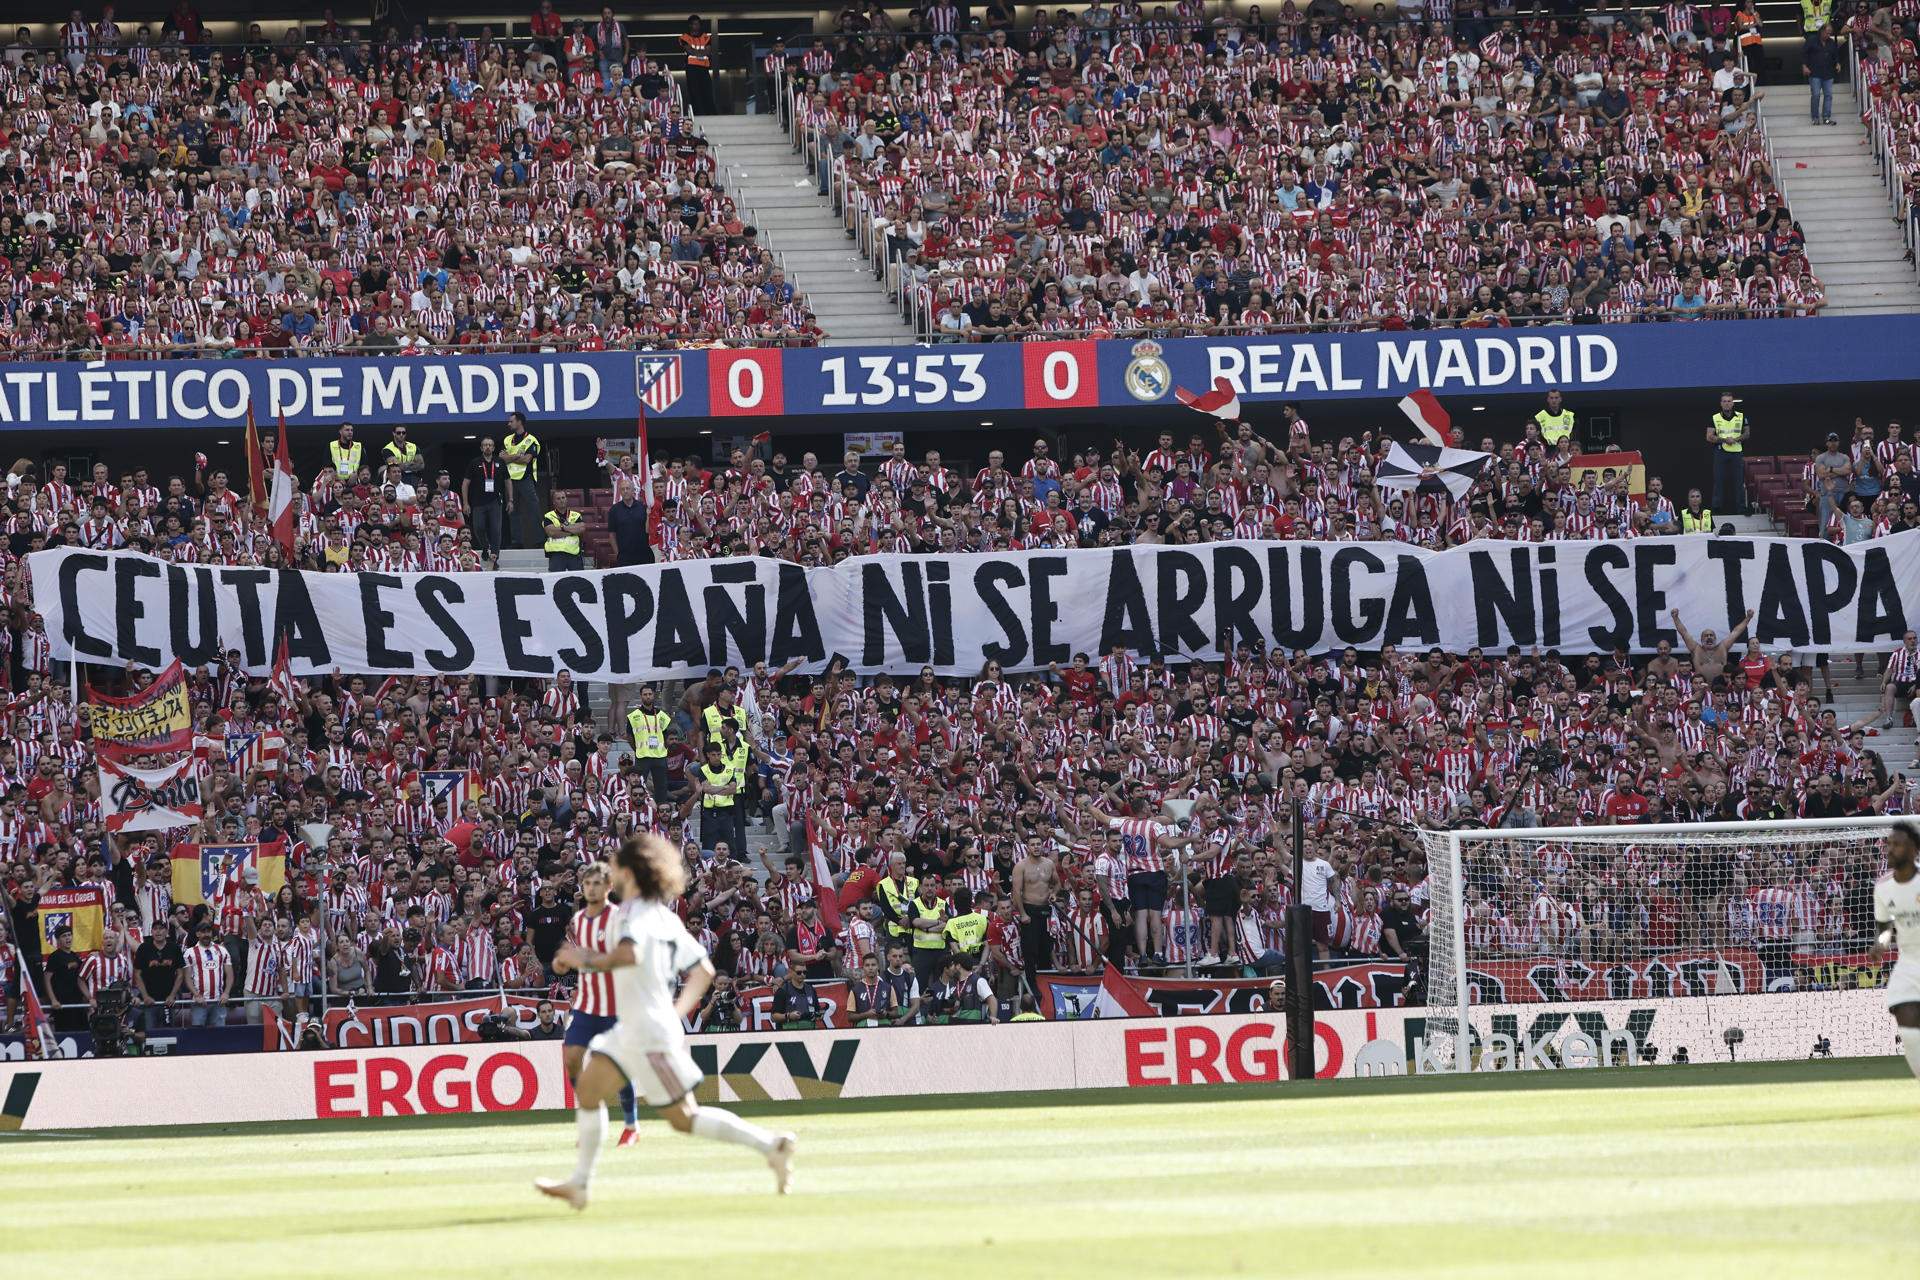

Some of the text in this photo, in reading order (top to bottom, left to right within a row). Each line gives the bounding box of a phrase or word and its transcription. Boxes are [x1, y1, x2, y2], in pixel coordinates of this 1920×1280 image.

[267, 367, 345, 418] DE
[362, 362, 601, 416] MADRID
[729, 358, 764, 408] 0
[822, 353, 987, 406] 13:53
[1043, 350, 1079, 400] 0
[1207, 334, 1618, 394] REAL MADRID
[59, 553, 332, 675] CEUTA
[358, 571, 475, 671] ES
[494, 561, 826, 674] ESPAÑA
[974, 557, 1071, 668] SE
[1099, 547, 1441, 657] ARRUGA
[1585, 544, 1679, 652] SE
[1708, 540, 1908, 646] TAPA
[690, 1040, 861, 1103] KV
[1124, 1021, 1344, 1087] ERGO
[313, 1052, 540, 1119] ERGO
